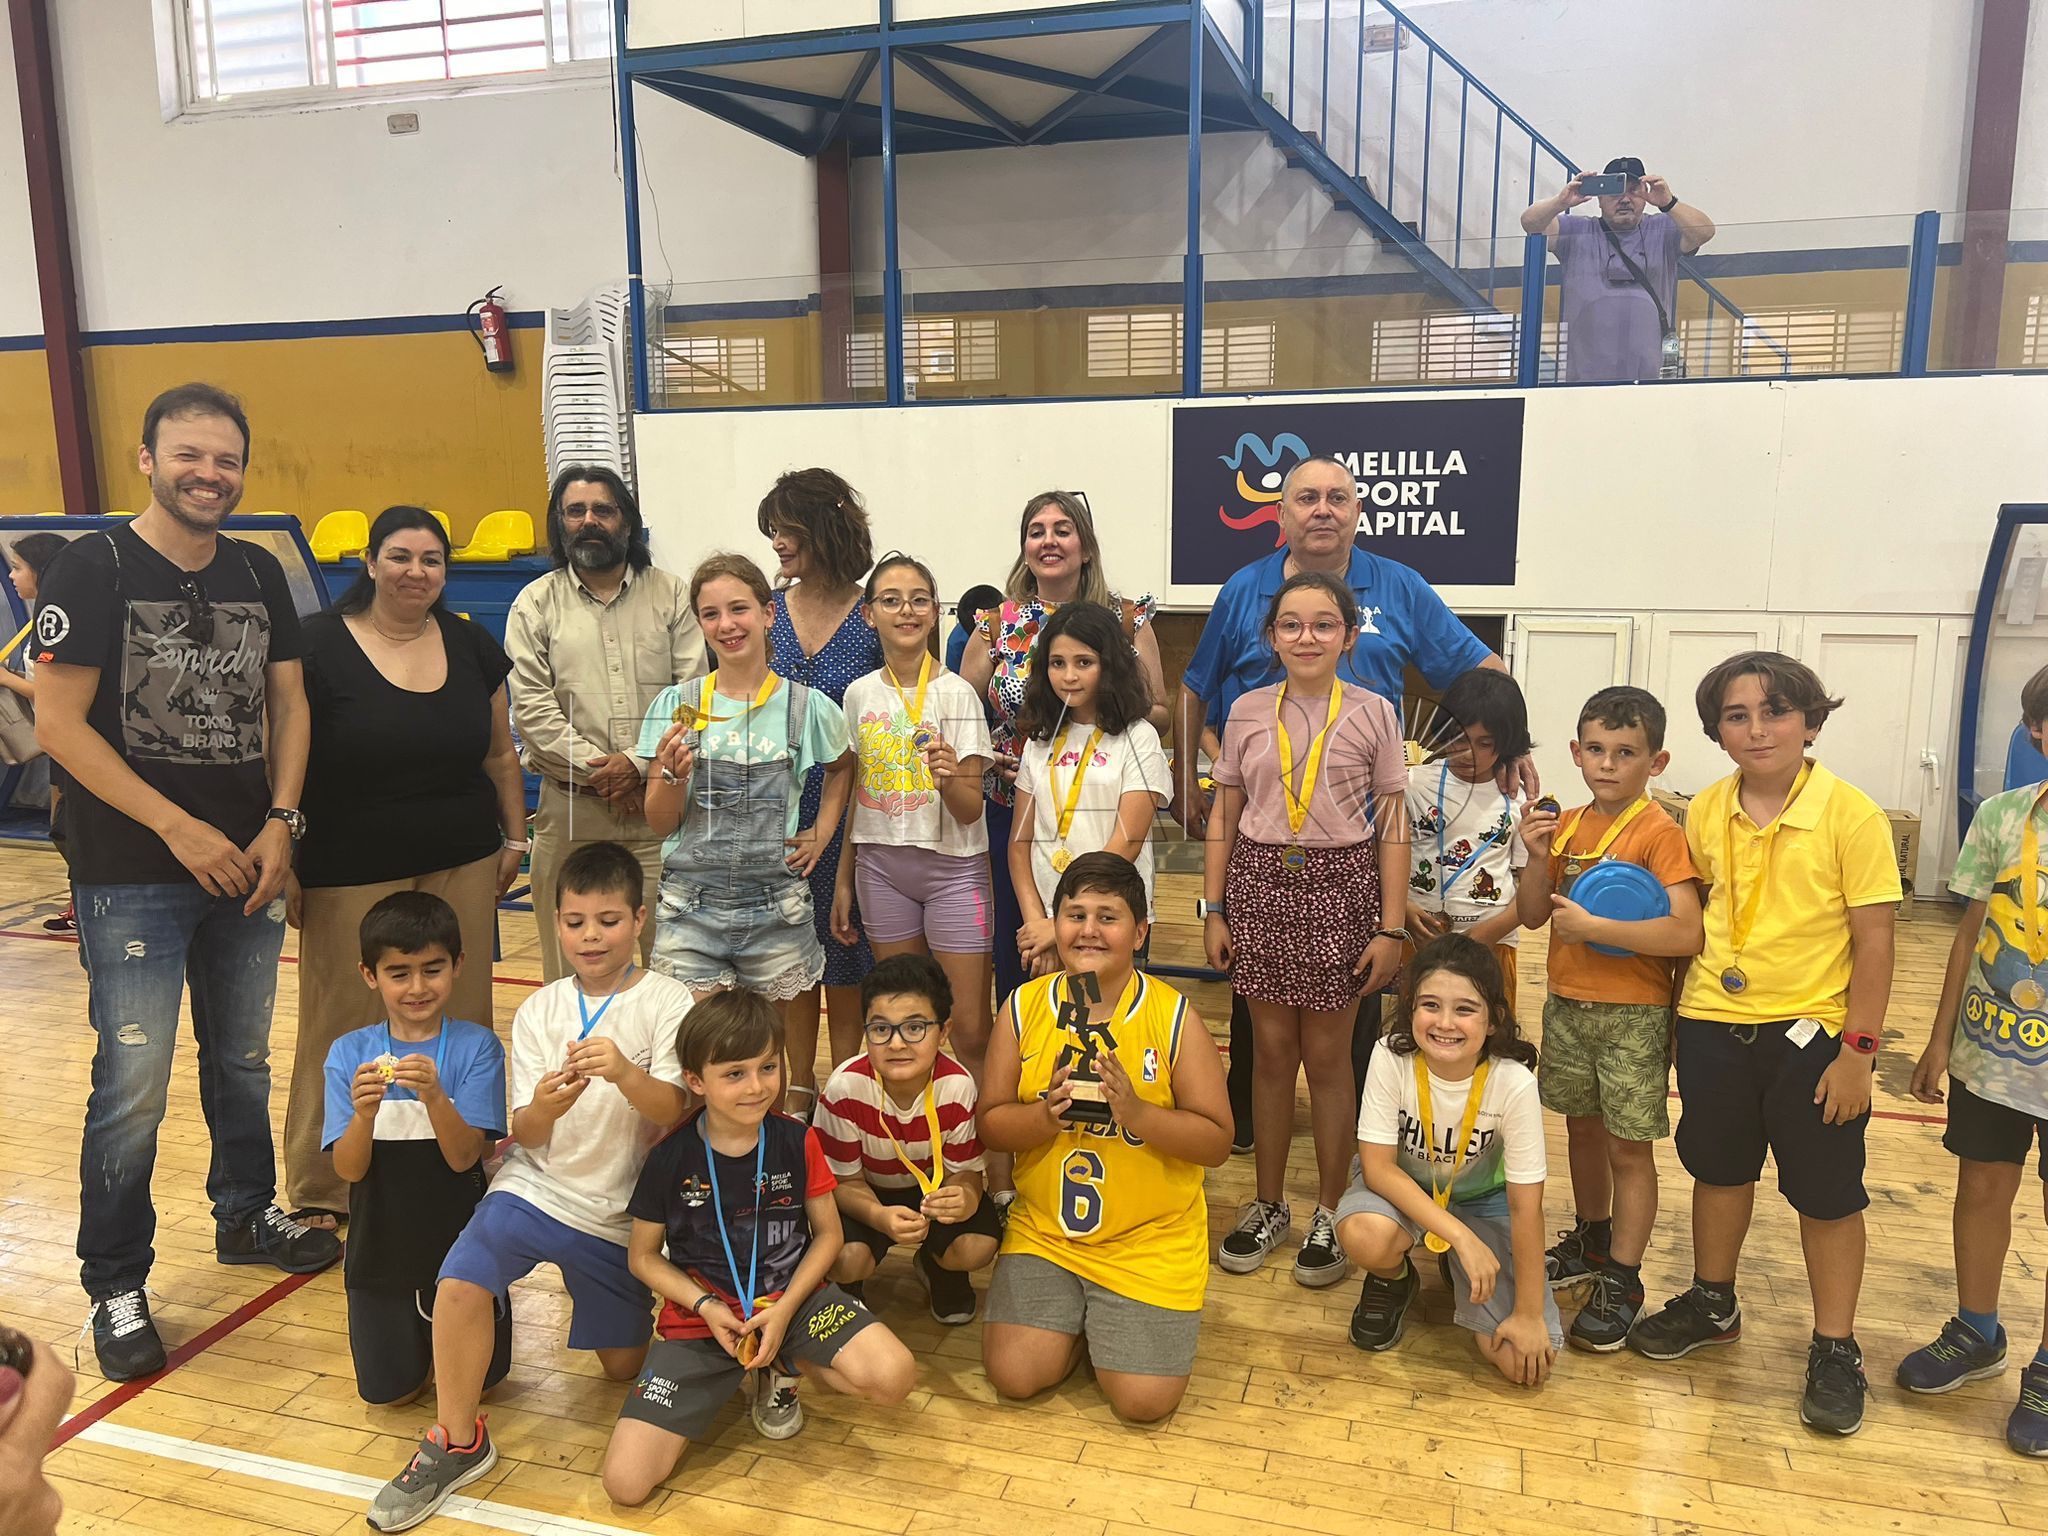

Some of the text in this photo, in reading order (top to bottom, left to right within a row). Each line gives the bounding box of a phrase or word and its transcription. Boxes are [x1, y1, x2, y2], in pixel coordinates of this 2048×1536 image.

[1333, 450, 1467, 476] MELILLA
[1356, 480, 1440, 506] PORT
[1355, 510, 1466, 536] APITAL
[184, 714, 236, 731] TOKYO
[182, 733, 236, 748] BRAND
[1058, 1148, 1105, 1238] 6
[647, 1383, 671, 1398] SPORT
[650, 1376, 679, 1392] MELILLA
[642, 1391, 673, 1408] CAPITAL
